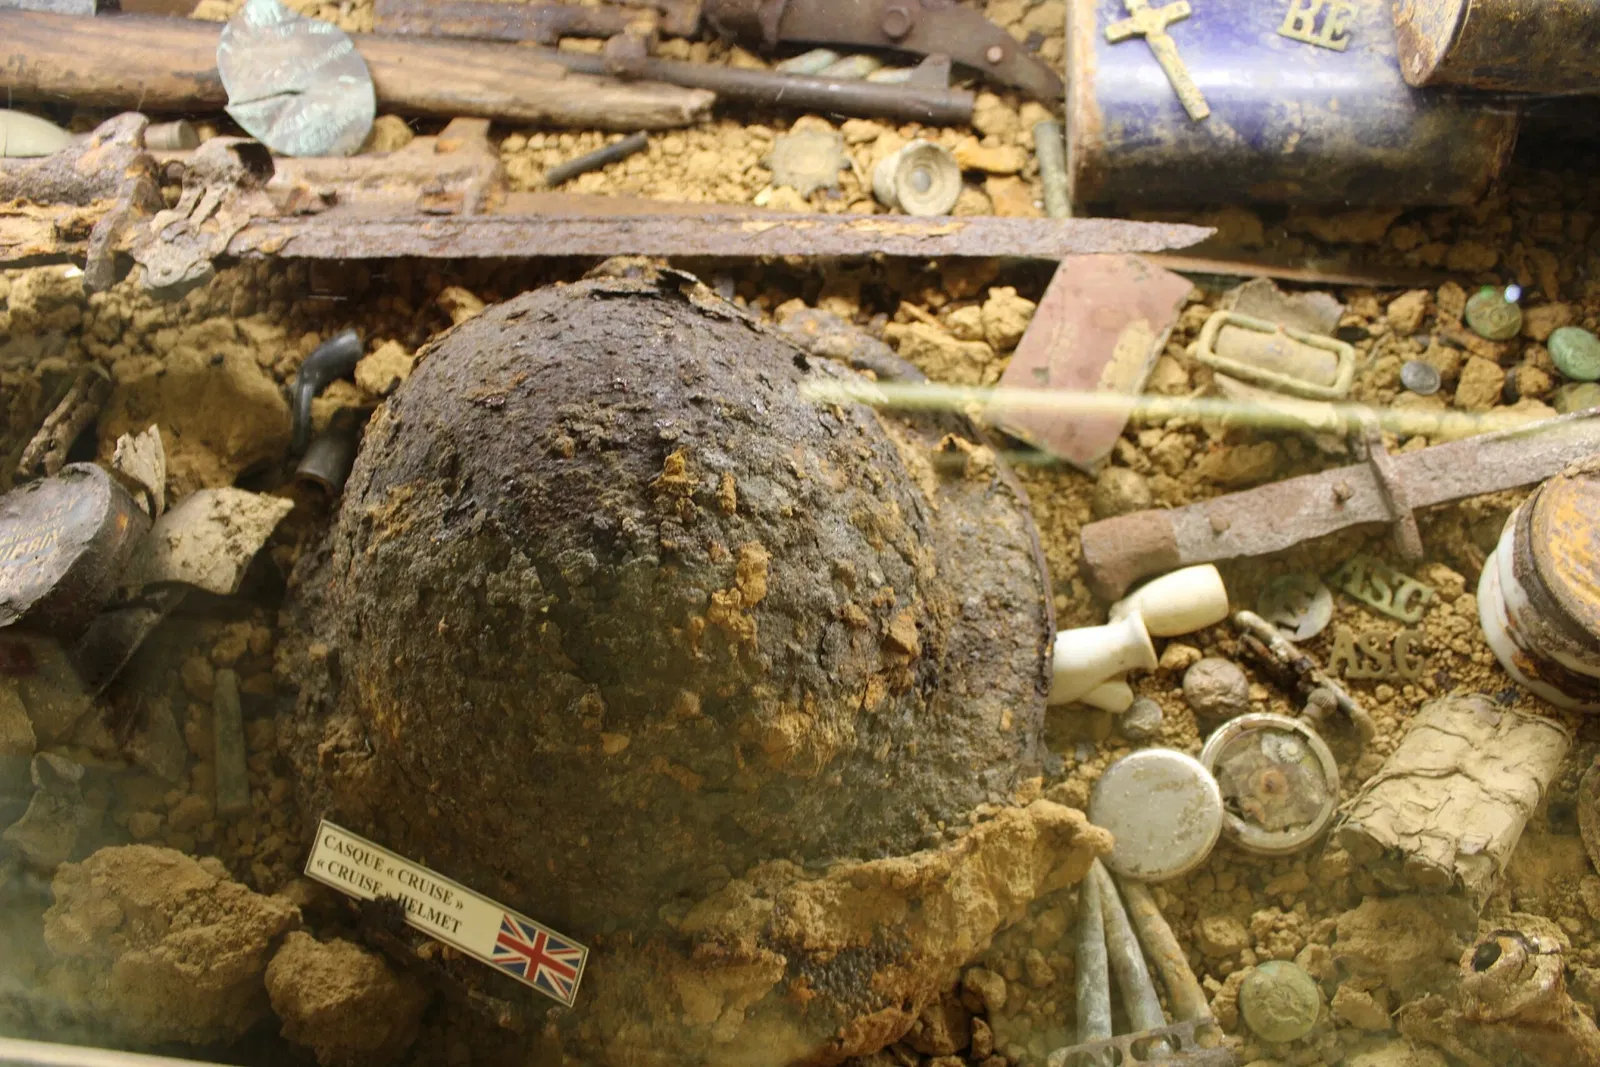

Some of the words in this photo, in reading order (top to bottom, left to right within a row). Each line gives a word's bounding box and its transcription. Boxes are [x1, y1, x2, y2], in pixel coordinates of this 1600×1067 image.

[1332, 554, 1434, 623] ASC
[1326, 624, 1425, 680] ASC
[324, 834, 385, 872] CASQUE
[398, 866, 454, 907] CRUISE
[327, 861, 384, 896] CRUISE
[397, 891, 463, 934] HELMET
